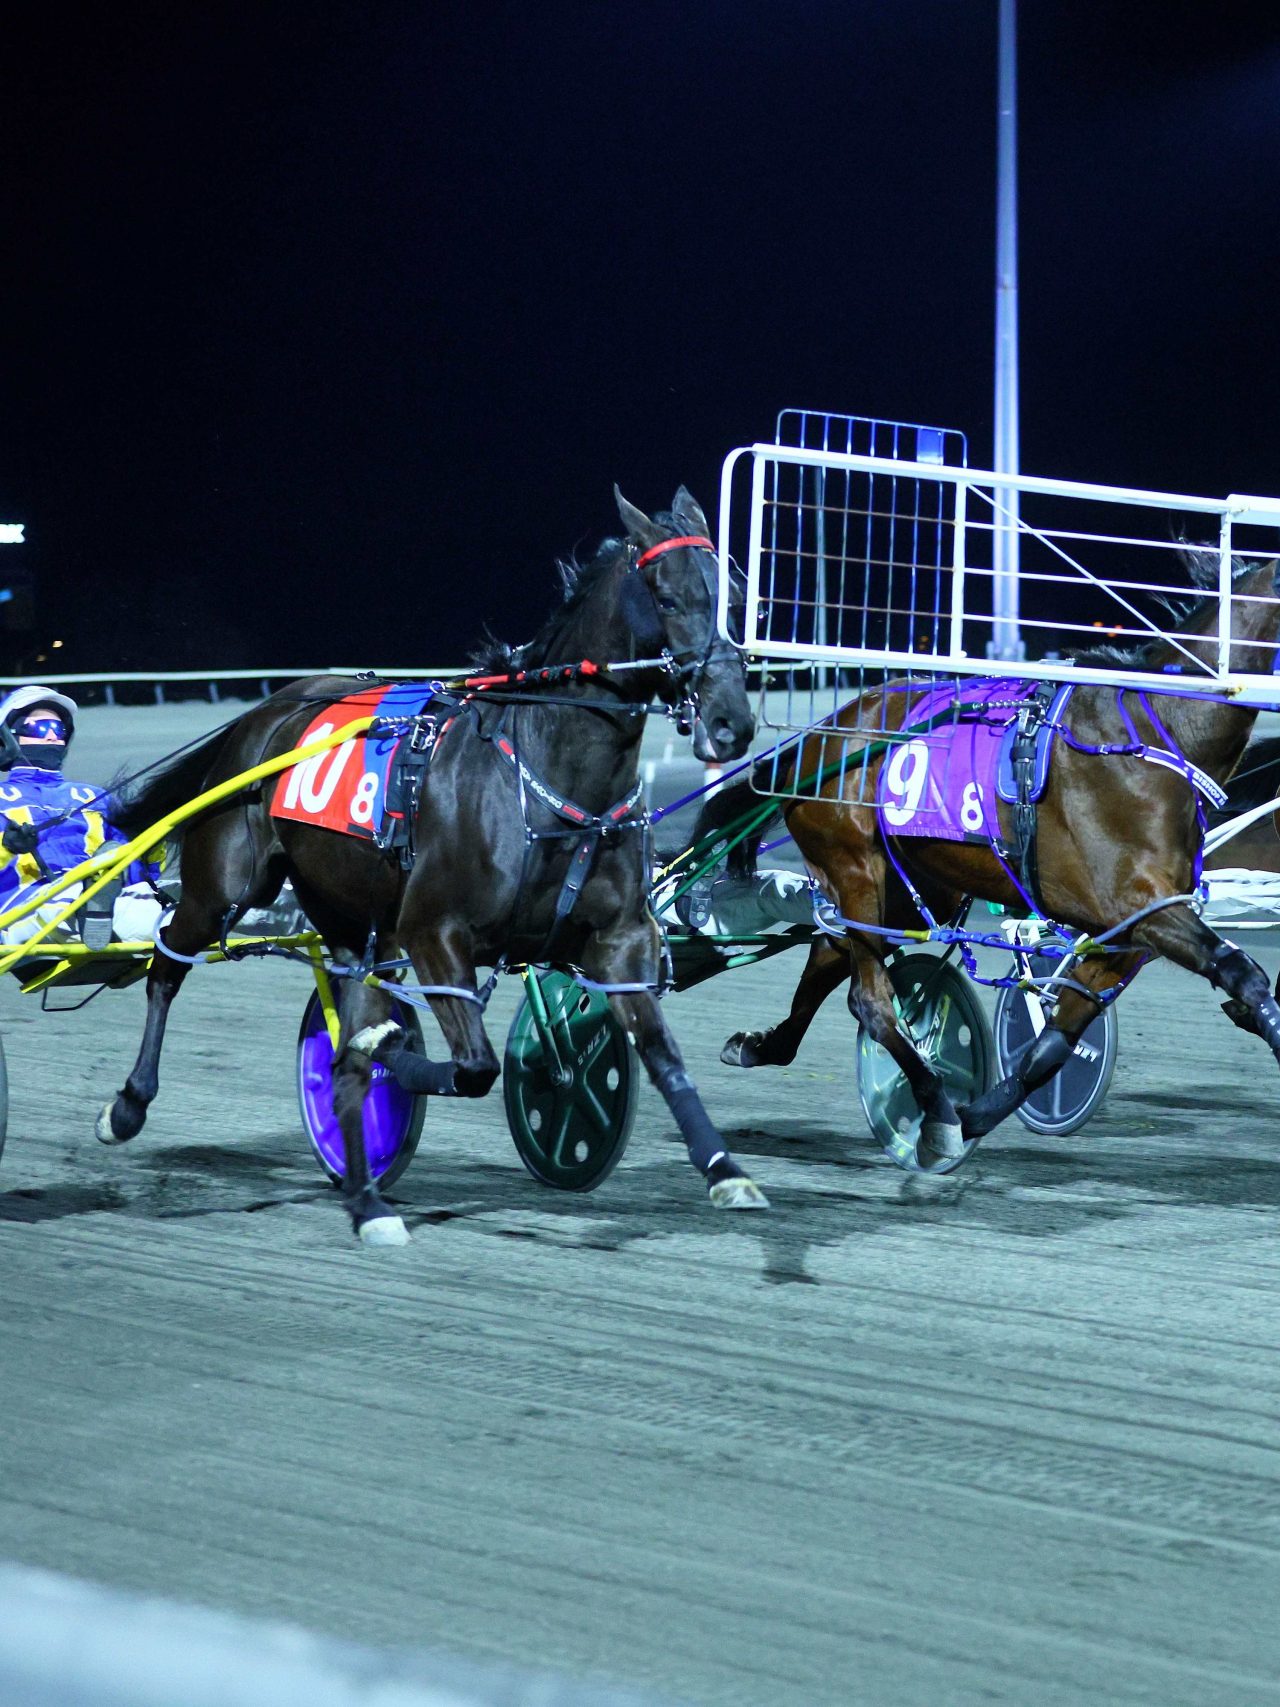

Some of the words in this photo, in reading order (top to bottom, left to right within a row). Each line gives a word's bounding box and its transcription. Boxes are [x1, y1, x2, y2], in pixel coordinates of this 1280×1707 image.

[283, 722, 358, 814] 10
[350, 772, 379, 823] 8
[884, 739, 929, 826] 9
[961, 781, 984, 831] 8
